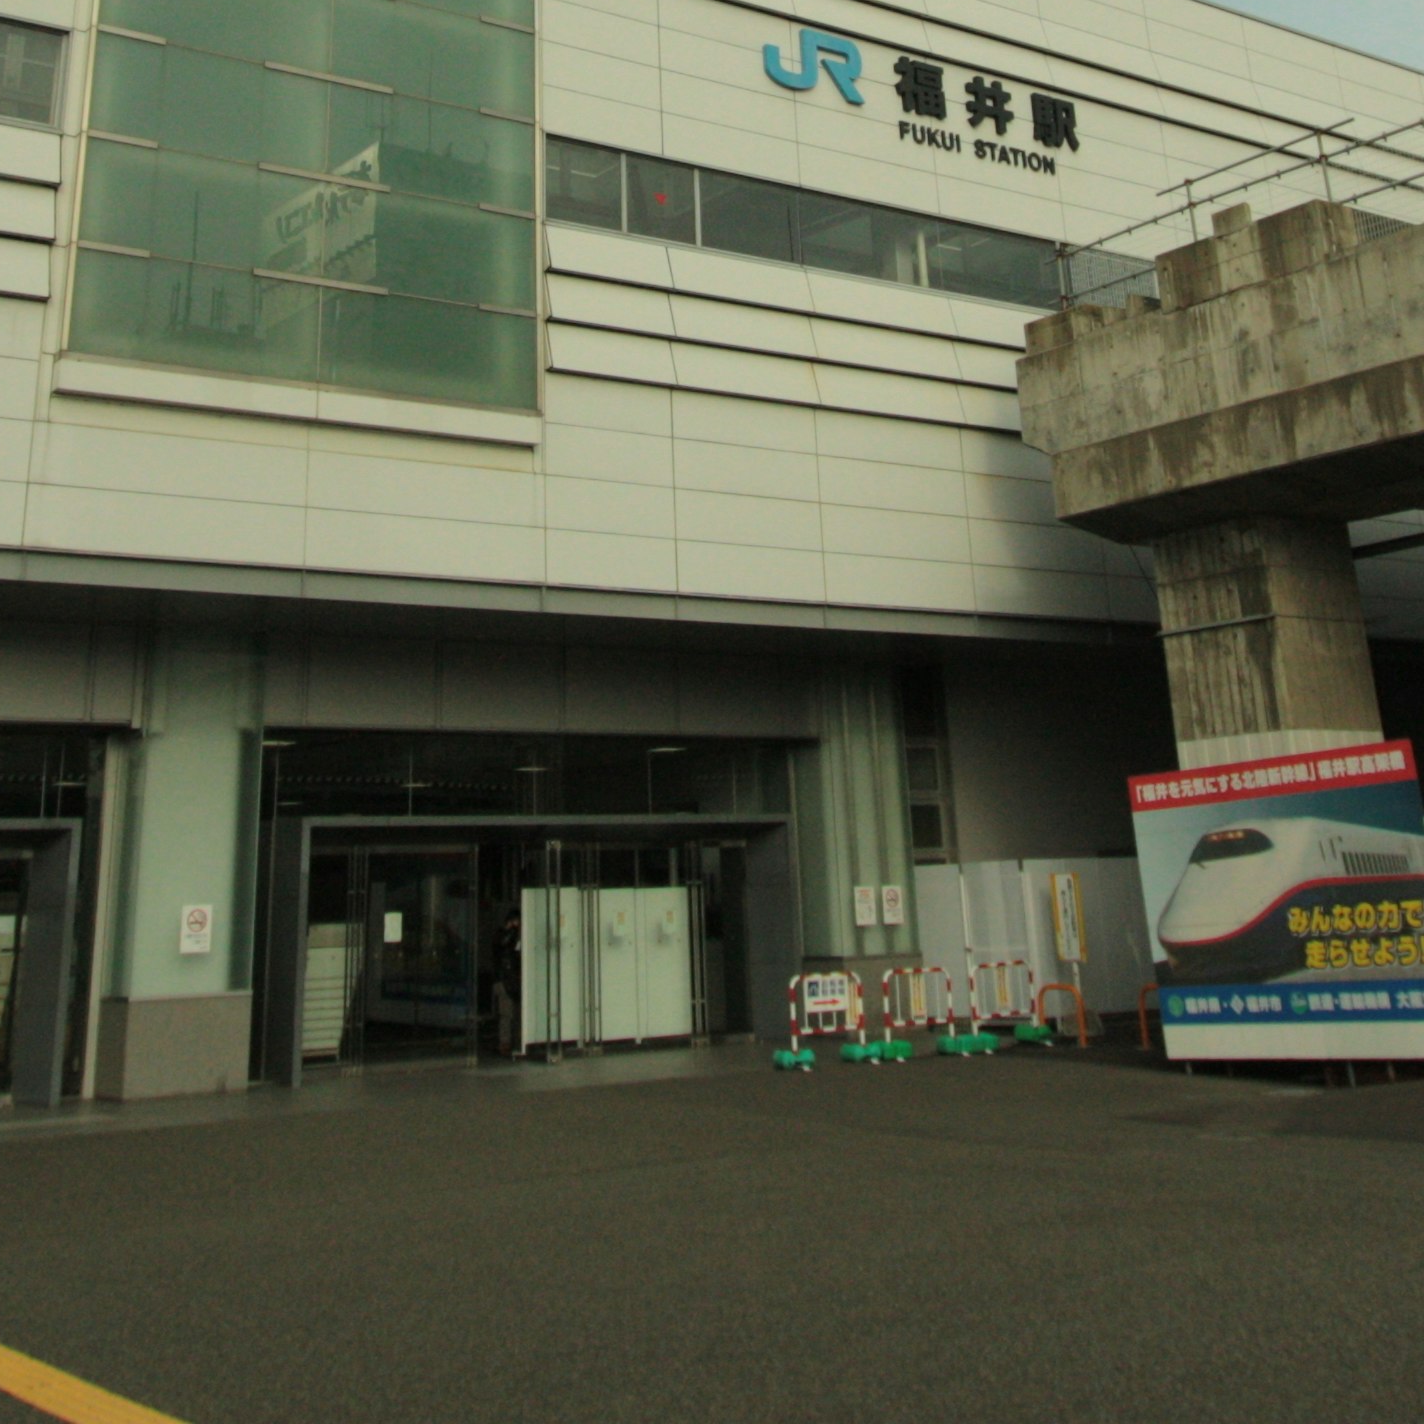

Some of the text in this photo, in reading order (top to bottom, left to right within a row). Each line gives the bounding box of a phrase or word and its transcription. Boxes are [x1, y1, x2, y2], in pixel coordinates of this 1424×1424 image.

[763, 28, 864, 105] JR
[893, 56, 1079, 152] 福井駅
[898, 121, 1056, 175] FUKUI STATION
[1288, 900, 1424, 936] みんなの力で
